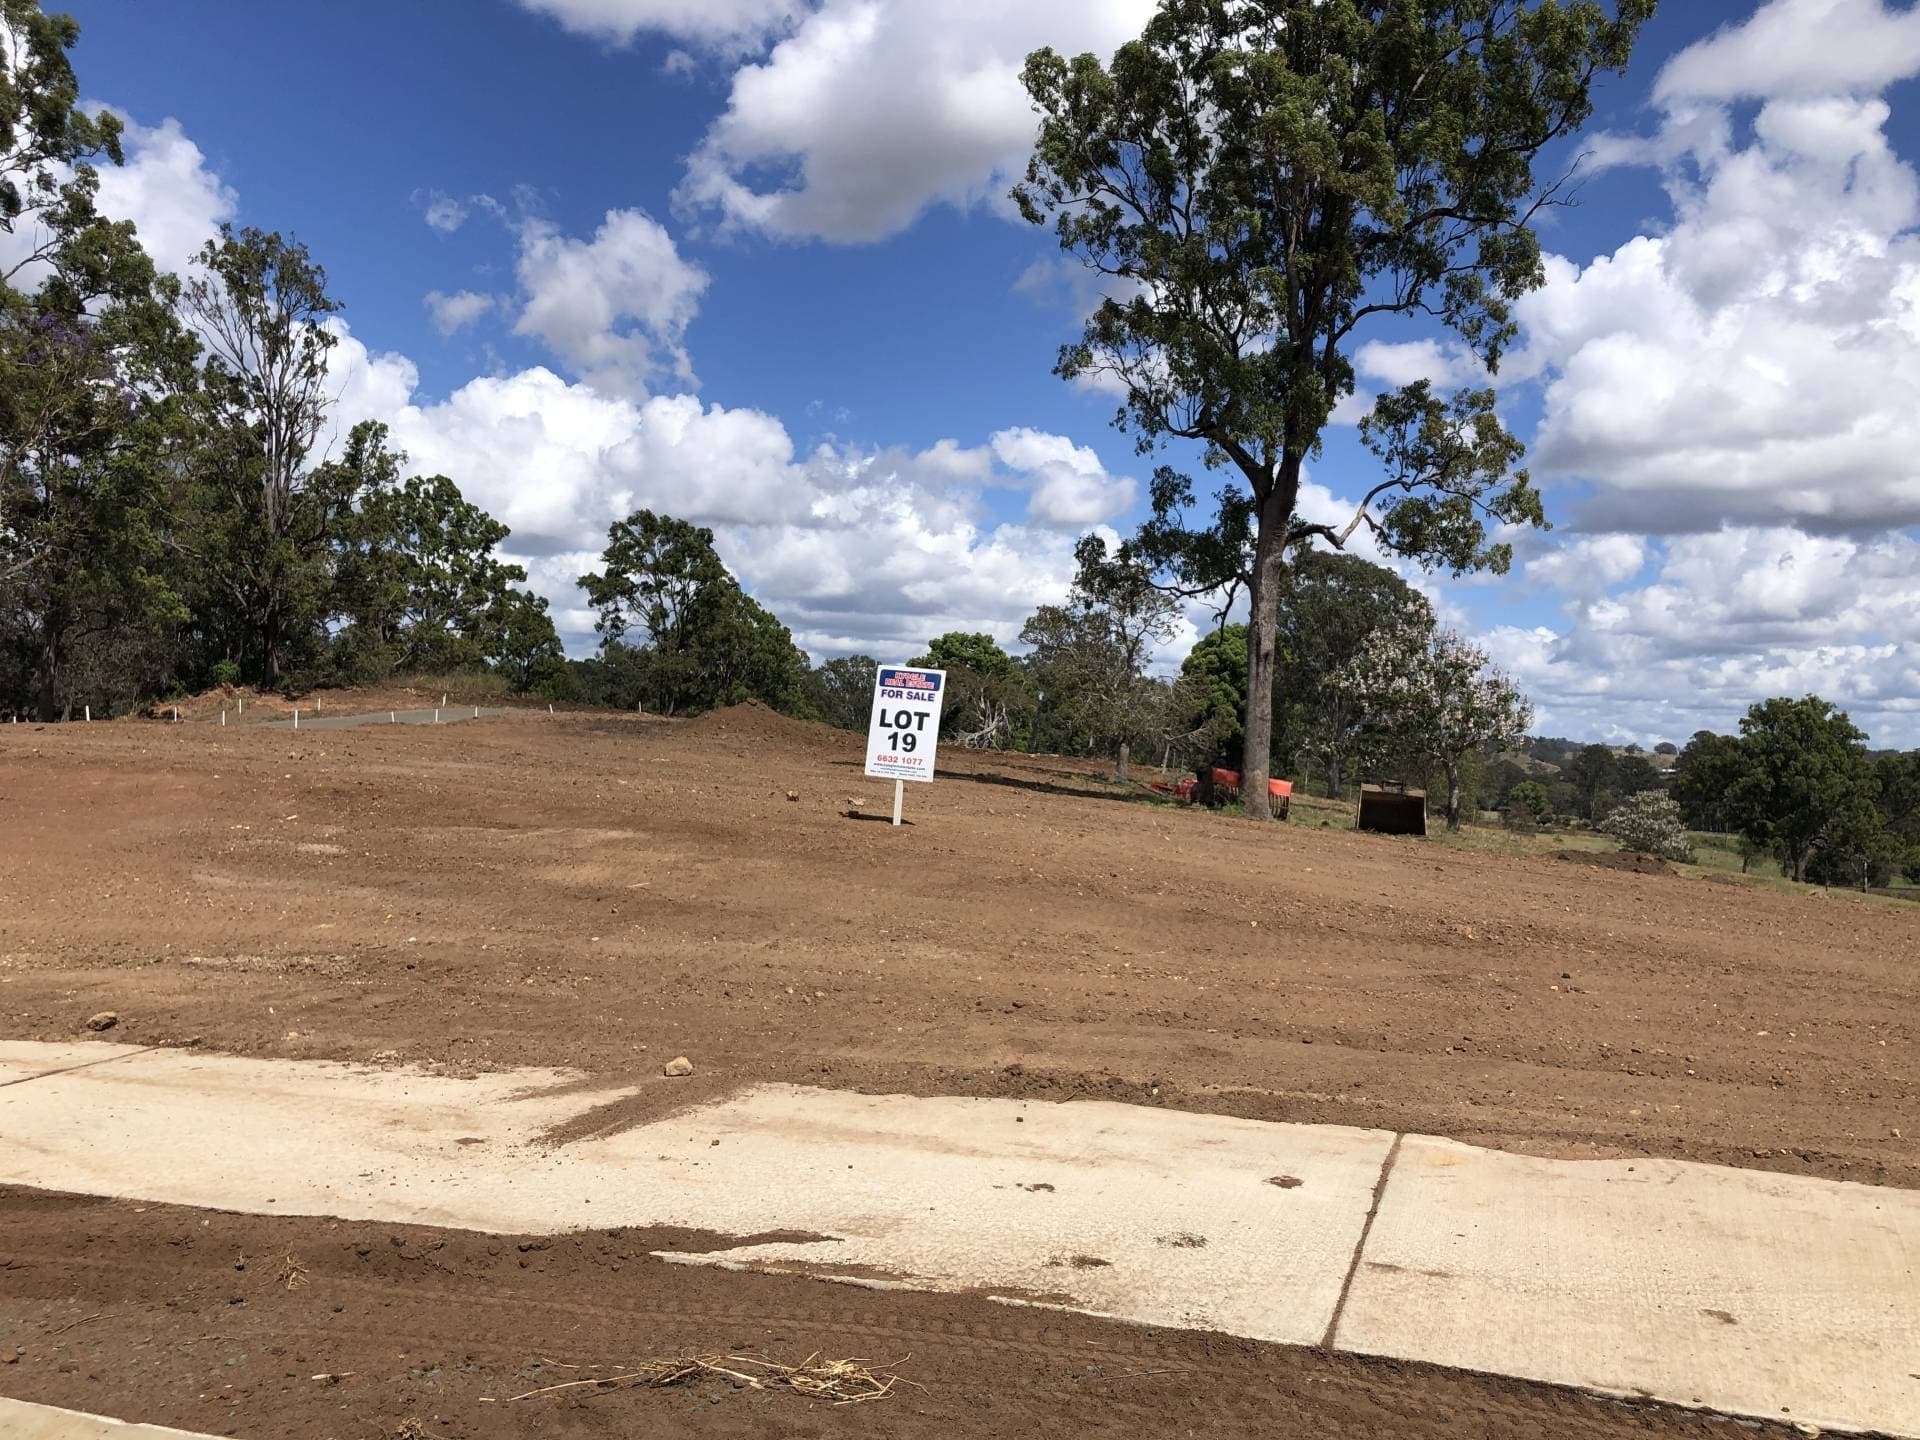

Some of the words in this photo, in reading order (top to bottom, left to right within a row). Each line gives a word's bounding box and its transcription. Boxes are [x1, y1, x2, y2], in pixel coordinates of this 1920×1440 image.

[881, 689, 903, 699] FOR
[906, 691, 935, 702] SALE
[879, 708, 930, 731] LOT
[887, 732, 917, 753] 19
[902, 756, 923, 766] 1077
